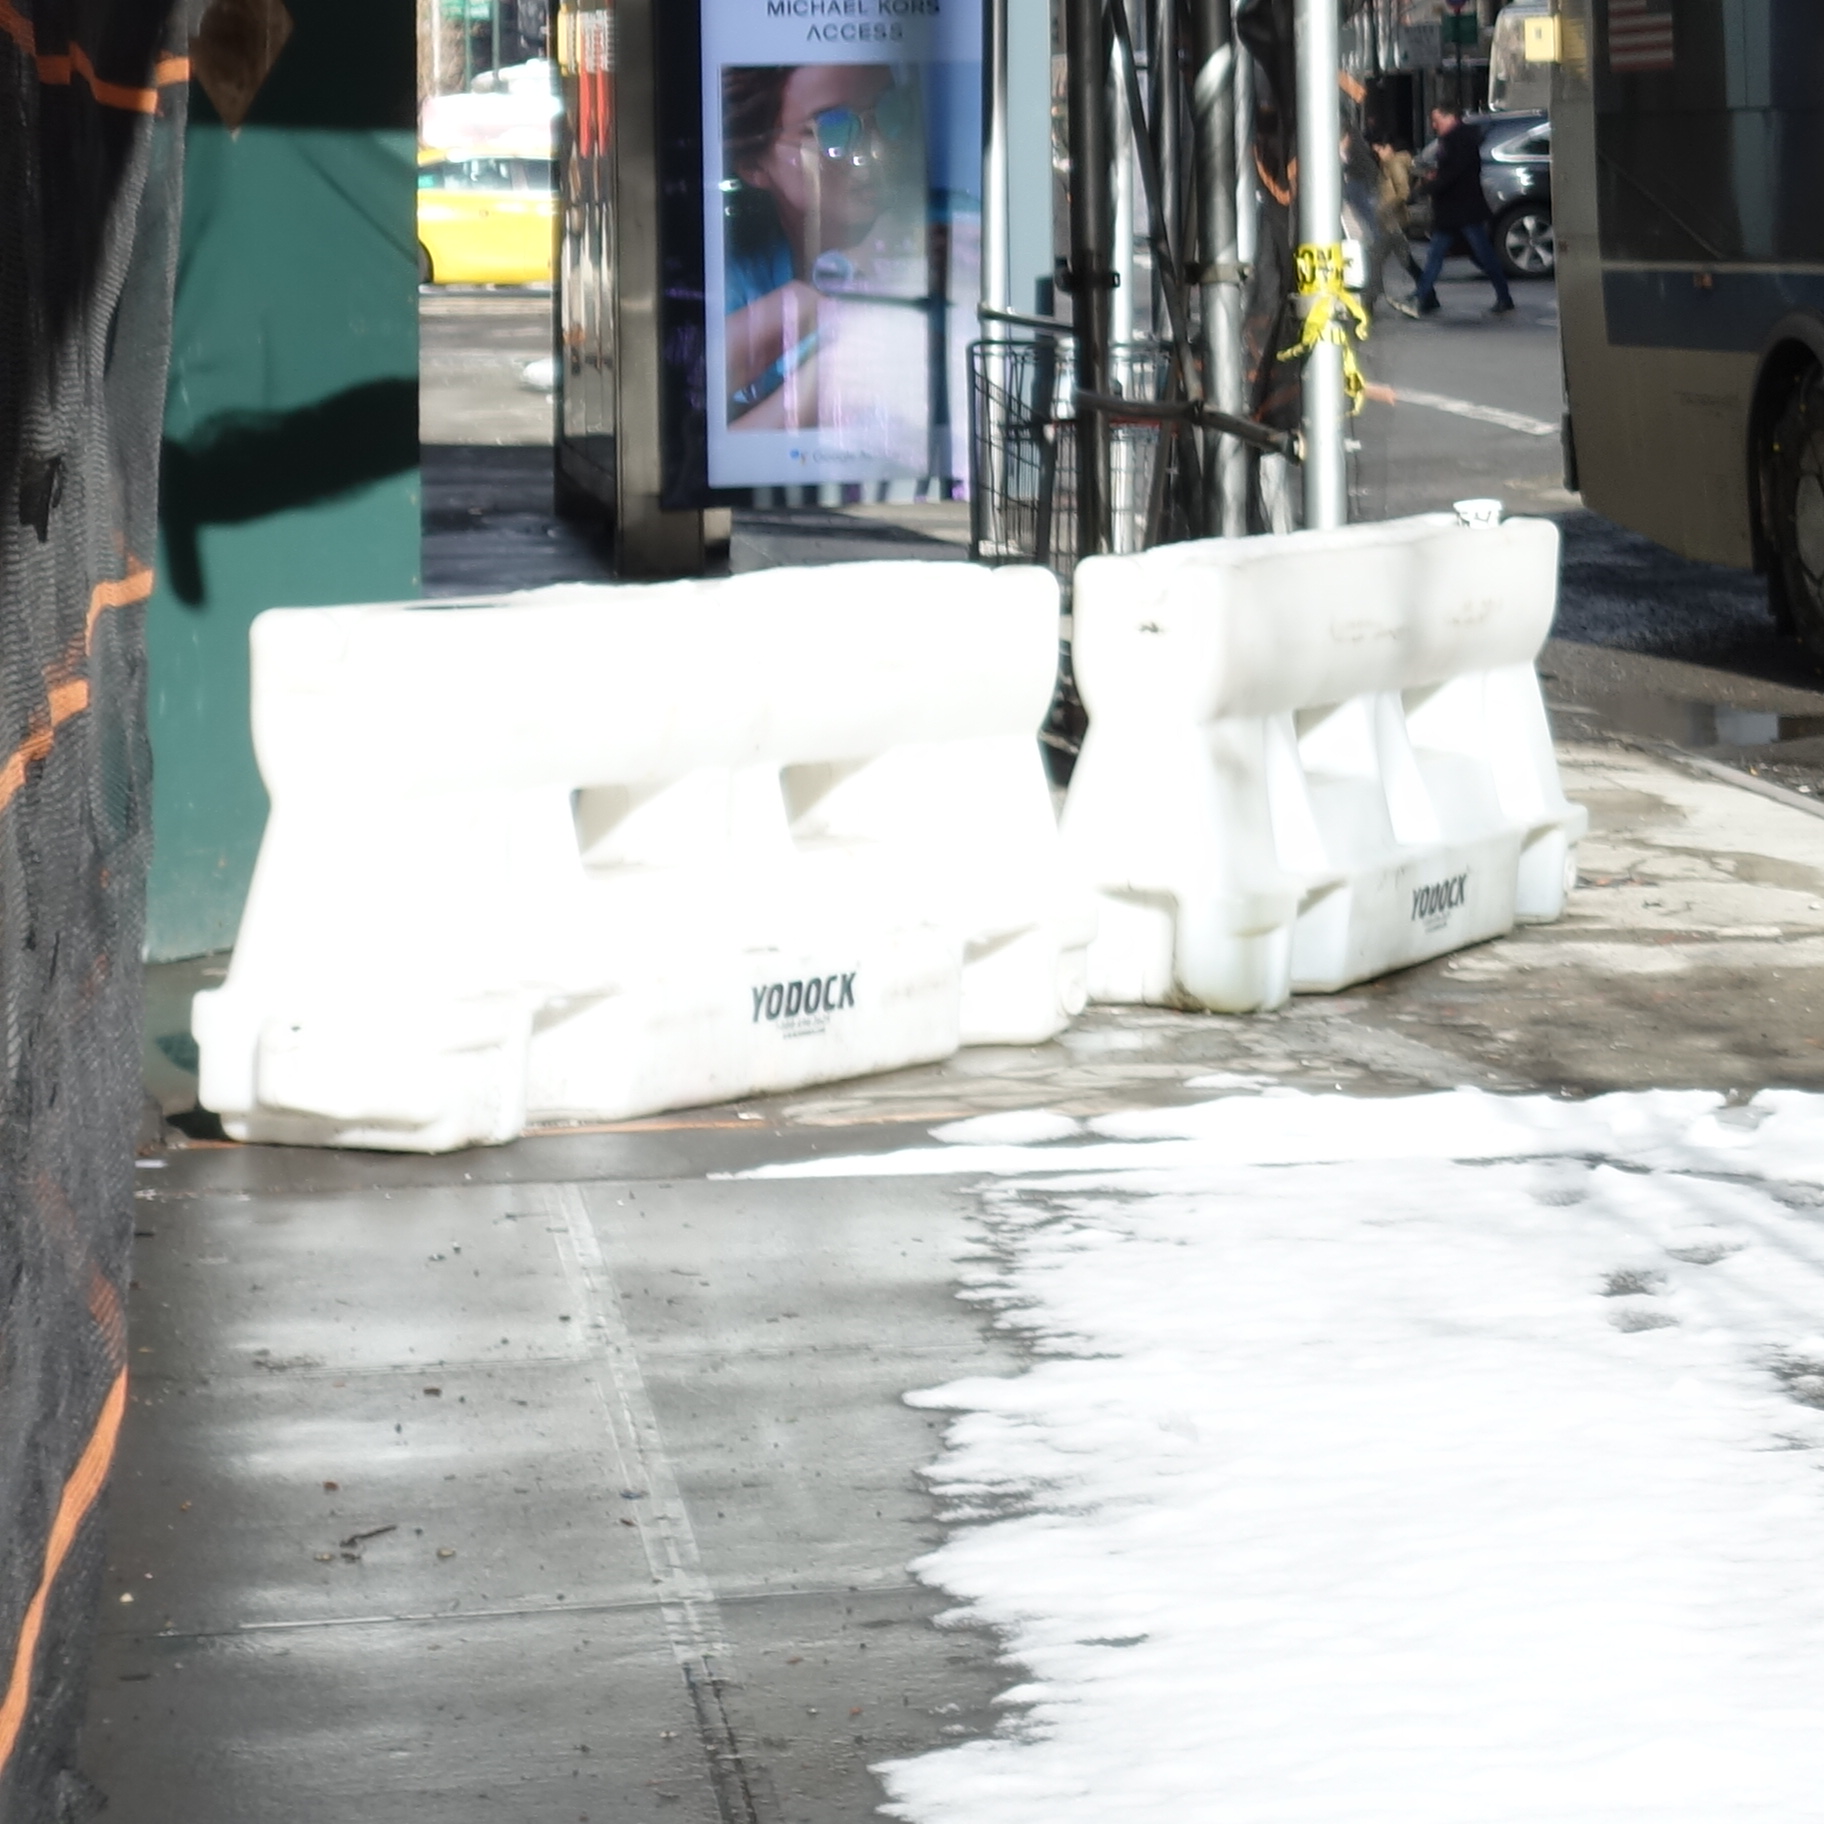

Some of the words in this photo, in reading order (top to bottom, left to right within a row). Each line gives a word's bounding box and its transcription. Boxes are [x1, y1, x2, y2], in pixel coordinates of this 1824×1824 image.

[806, 24, 904, 43] ACCESS
[1410, 871, 1468, 922] YODOCK
[751, 971, 857, 1024] YODOCK
